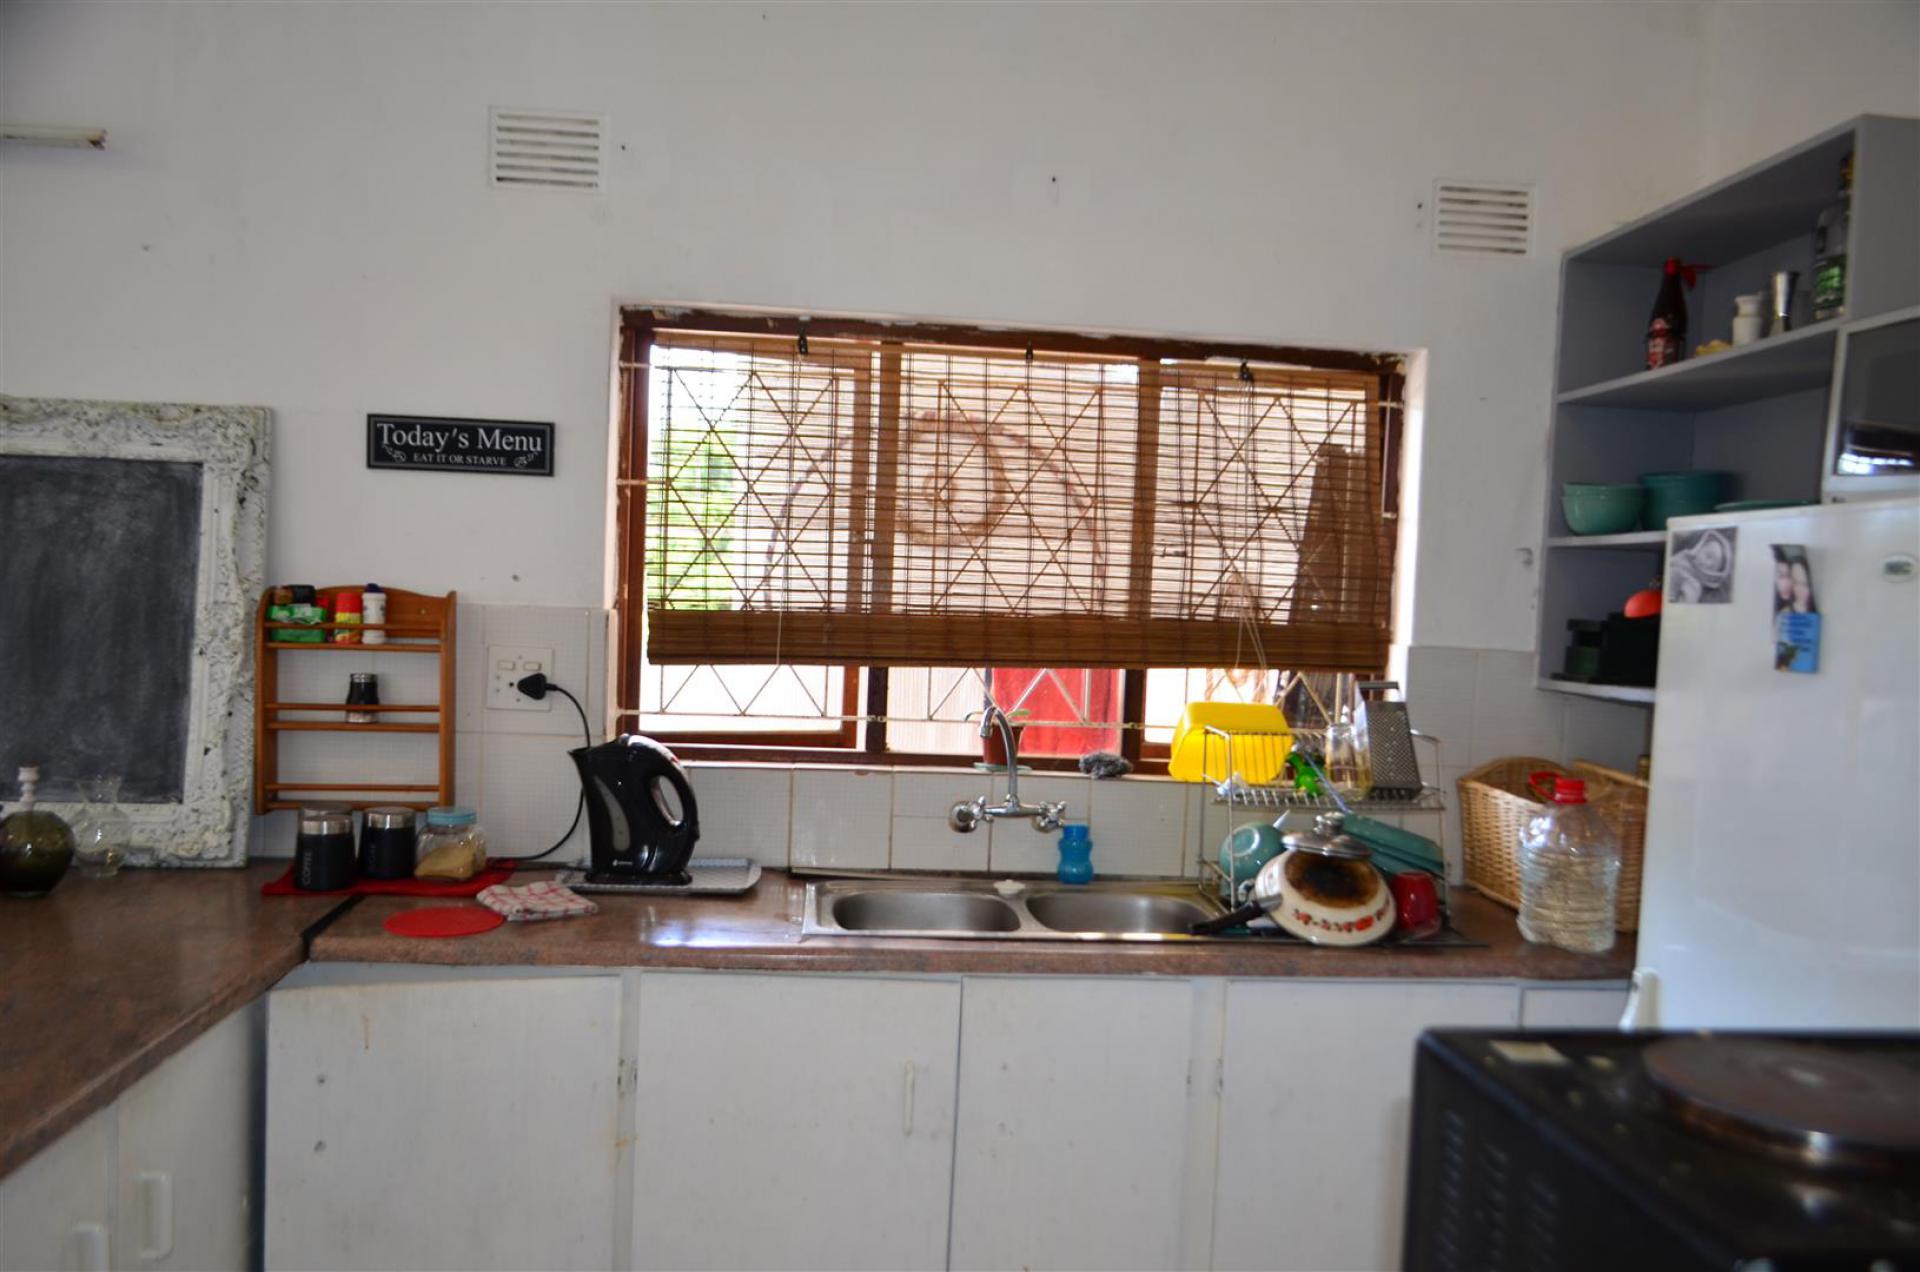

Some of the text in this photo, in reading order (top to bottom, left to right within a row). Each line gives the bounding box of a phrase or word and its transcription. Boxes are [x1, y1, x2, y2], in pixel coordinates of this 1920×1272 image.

[376, 423, 542, 453] Today's Menu
[413, 453, 506, 466] EAT IT OR STARVE
